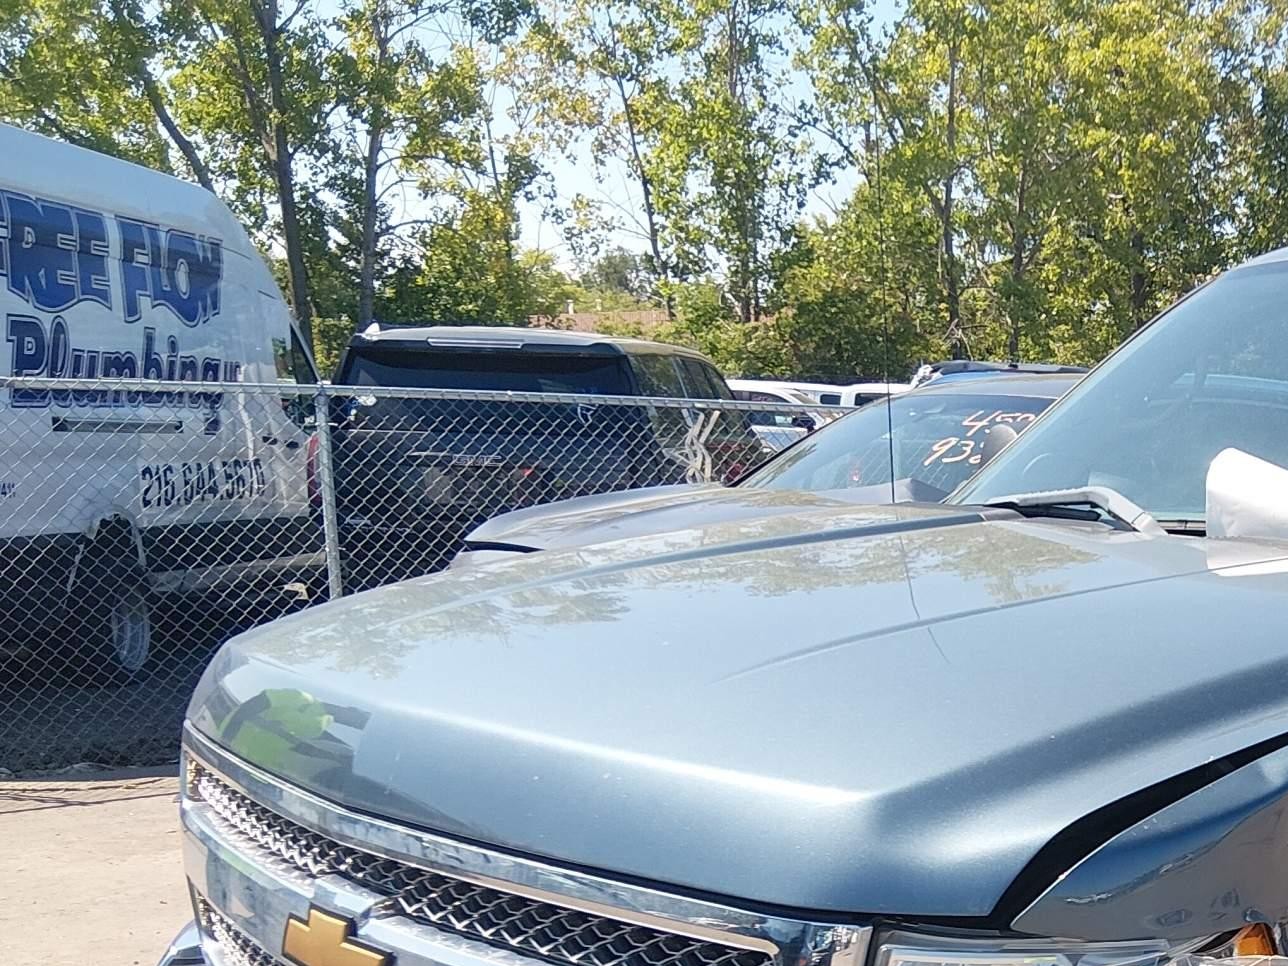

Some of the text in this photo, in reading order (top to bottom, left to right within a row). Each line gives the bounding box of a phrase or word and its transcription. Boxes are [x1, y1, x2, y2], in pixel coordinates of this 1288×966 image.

[0, 189, 224, 328] REE FLOW
[6, 313, 224, 435] Plumbing
